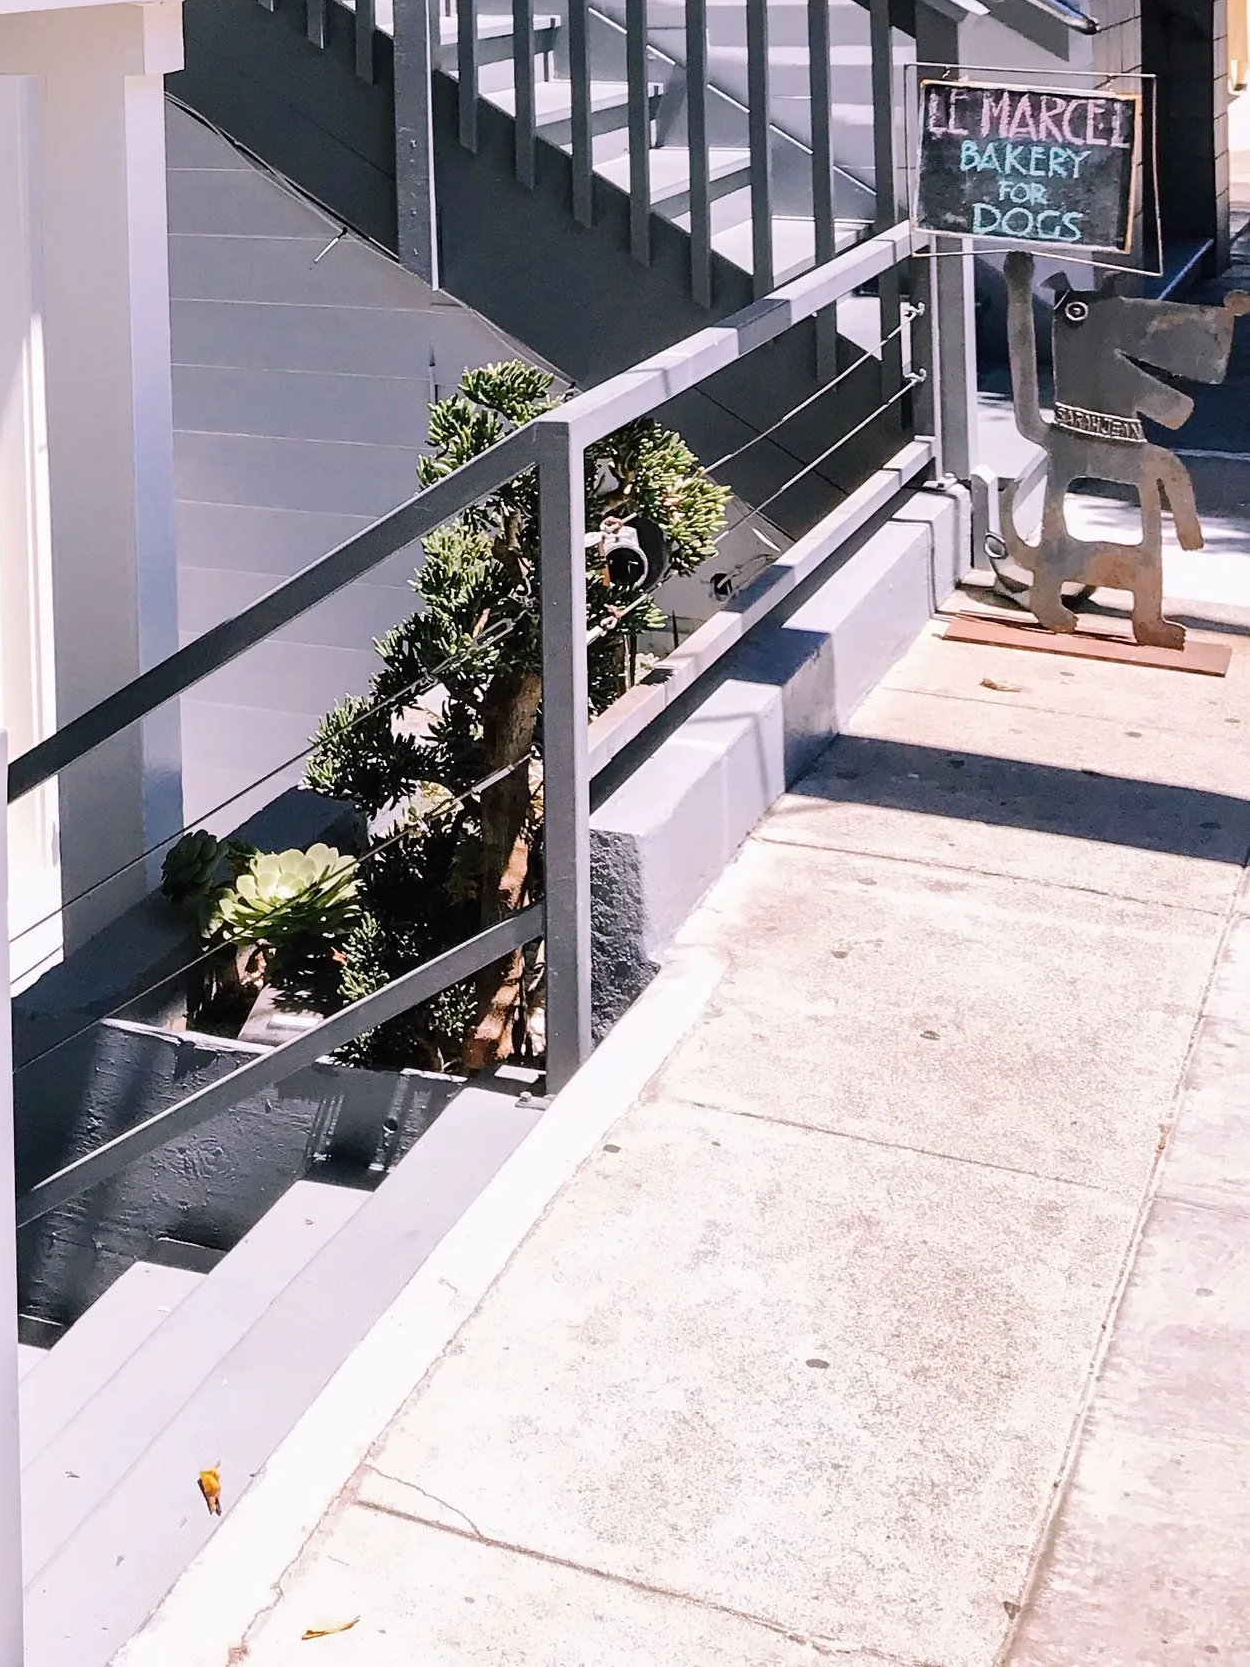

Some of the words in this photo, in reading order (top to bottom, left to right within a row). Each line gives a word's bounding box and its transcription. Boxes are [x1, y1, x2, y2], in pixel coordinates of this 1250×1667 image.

[928, 89, 969, 136] LE
[980, 90, 1132, 150] MARCEL
[959, 140, 1092, 180] BAKERY
[998, 179, 1048, 206] FOR
[972, 202, 1084, 242] DOGS
